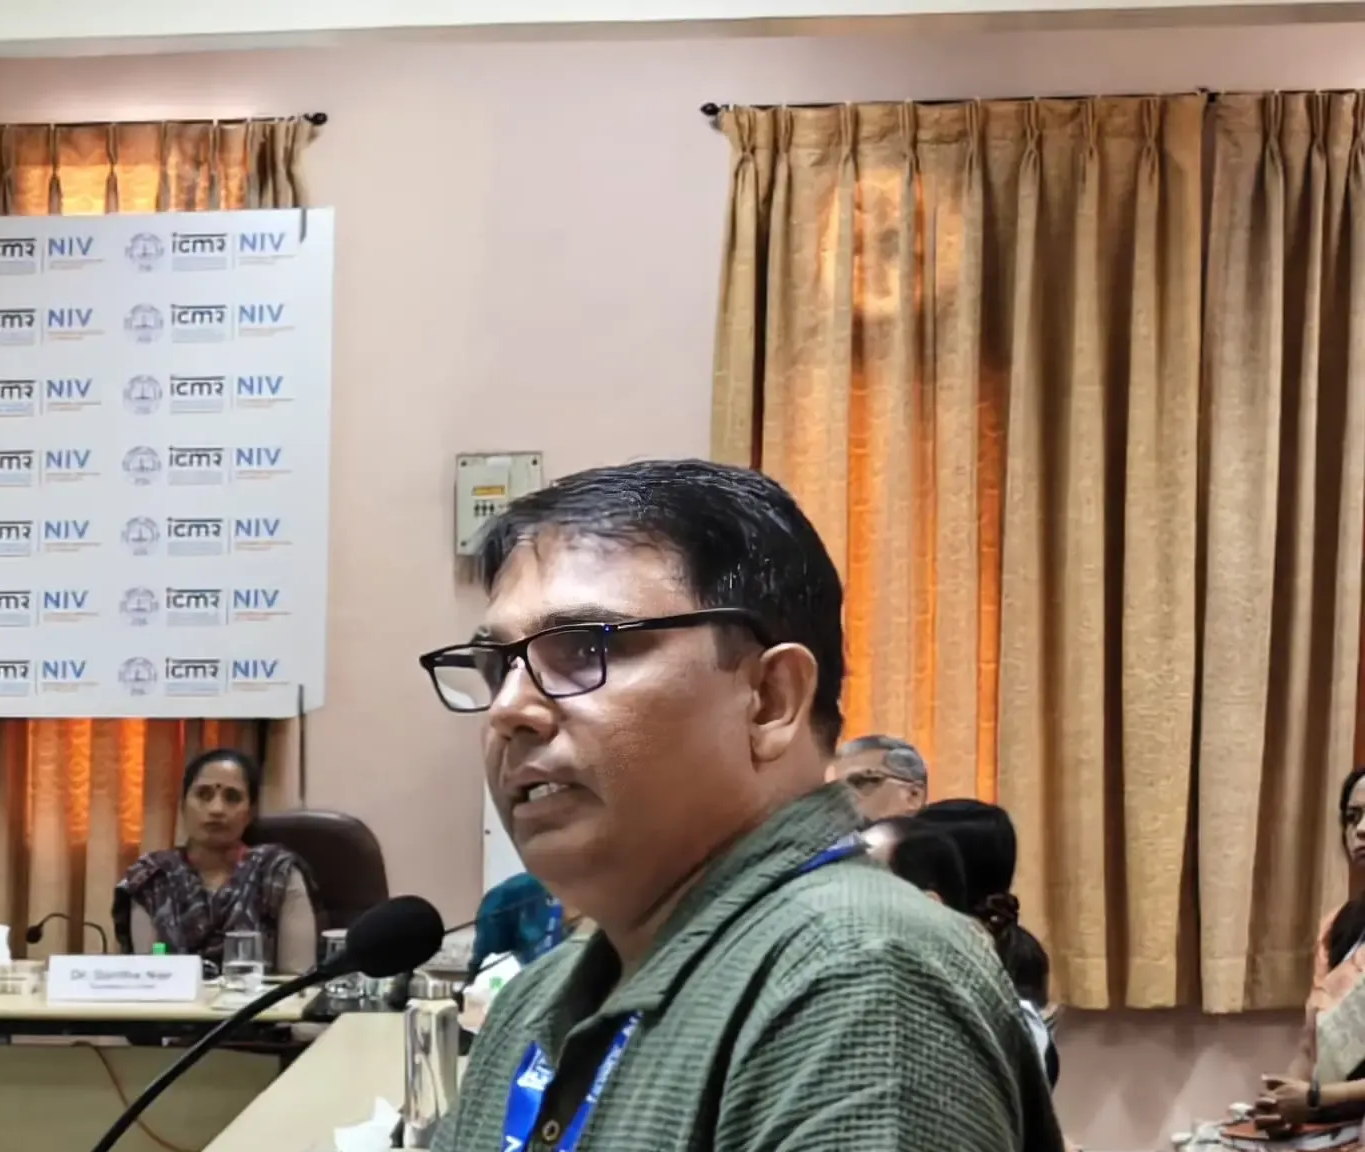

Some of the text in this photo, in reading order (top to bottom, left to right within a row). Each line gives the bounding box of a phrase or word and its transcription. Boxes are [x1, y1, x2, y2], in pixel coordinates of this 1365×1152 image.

[48, 237, 93, 256] NIV
[239, 233, 285, 252] NIV
[48, 308, 92, 327] NIV
[239, 304, 284, 324] NIV
[47, 379, 91, 398] NIV
[237, 376, 283, 395] NIV
[46, 450, 91, 469] NIV
[236, 448, 281, 466] NIV
[45, 520, 89, 539] NIV
[235, 518, 280, 537] NIV
[44, 591, 88, 609] NIV
[234, 589, 279, 608] NIV
[42, 660, 86, 679] NIV
[232, 660, 278, 678] NIV
